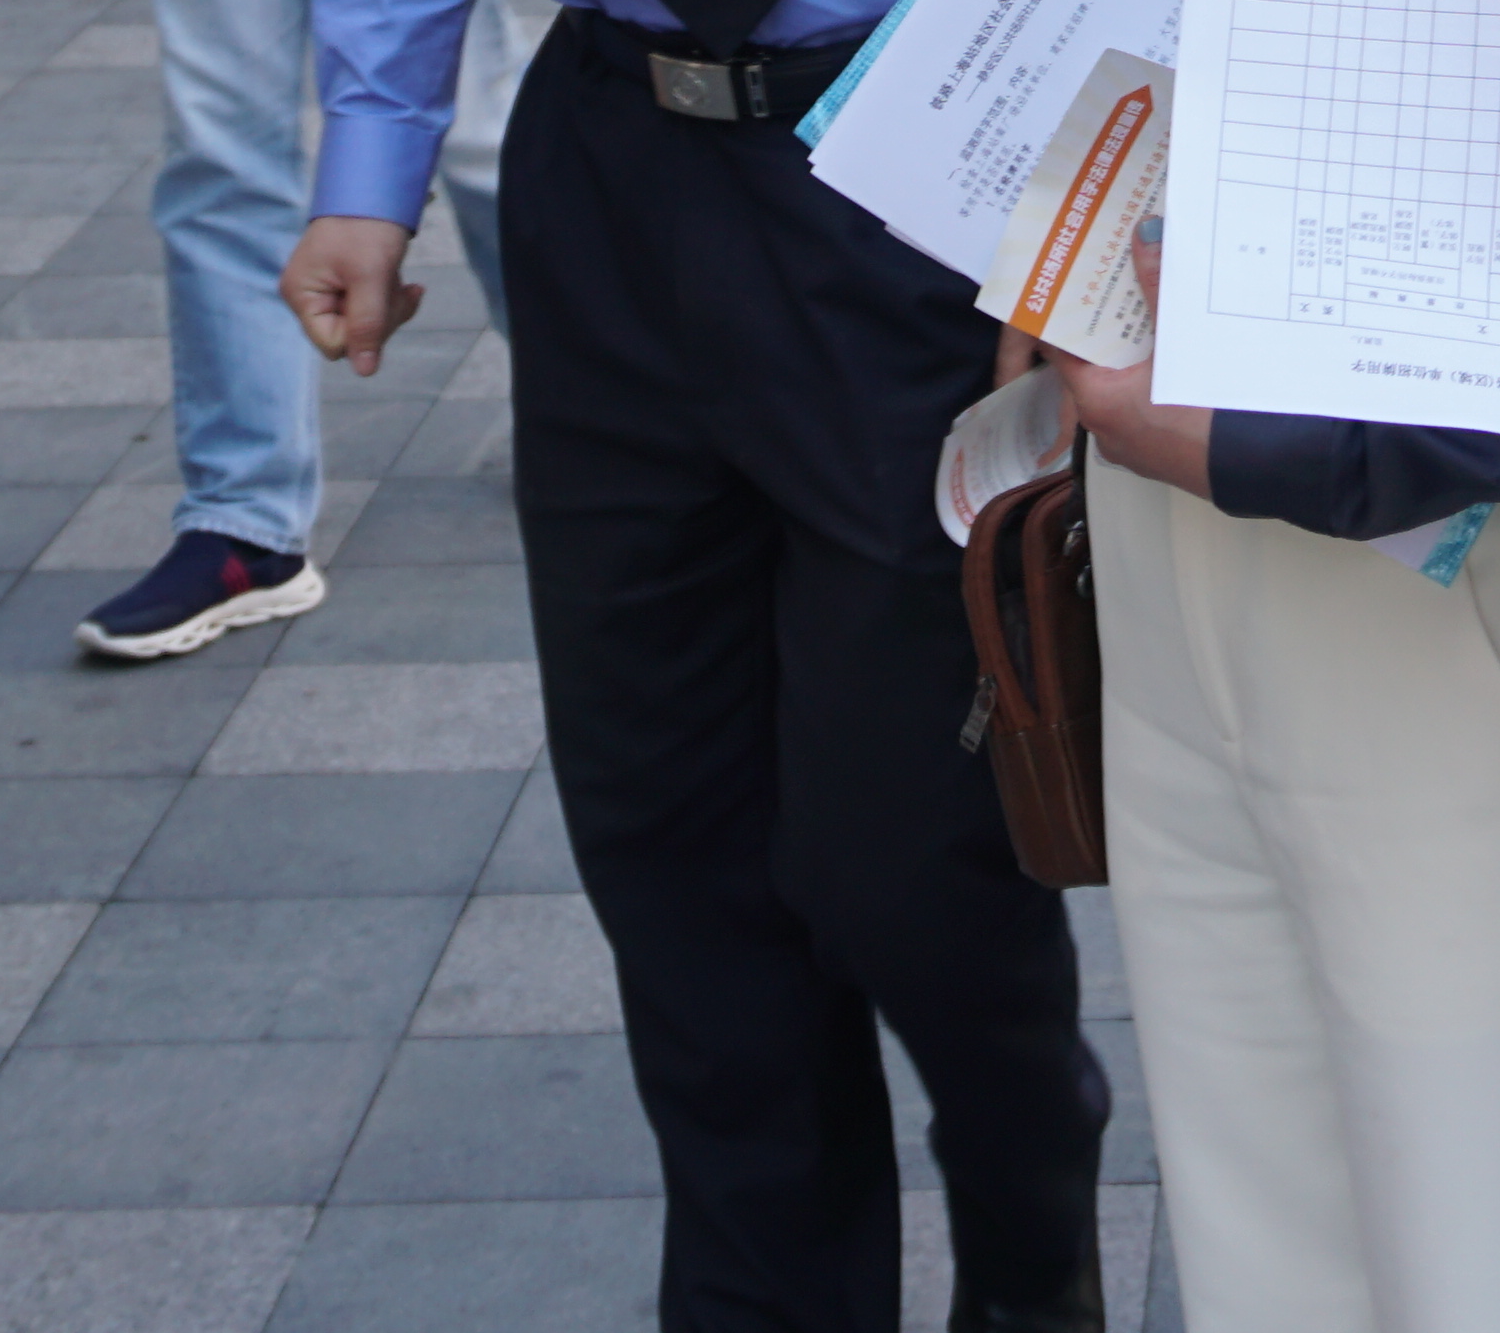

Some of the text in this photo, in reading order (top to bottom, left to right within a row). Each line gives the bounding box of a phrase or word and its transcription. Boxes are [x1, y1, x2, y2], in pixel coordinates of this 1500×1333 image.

[1024, 96, 1146, 311] 公共场所社会用字法律法规宣传
